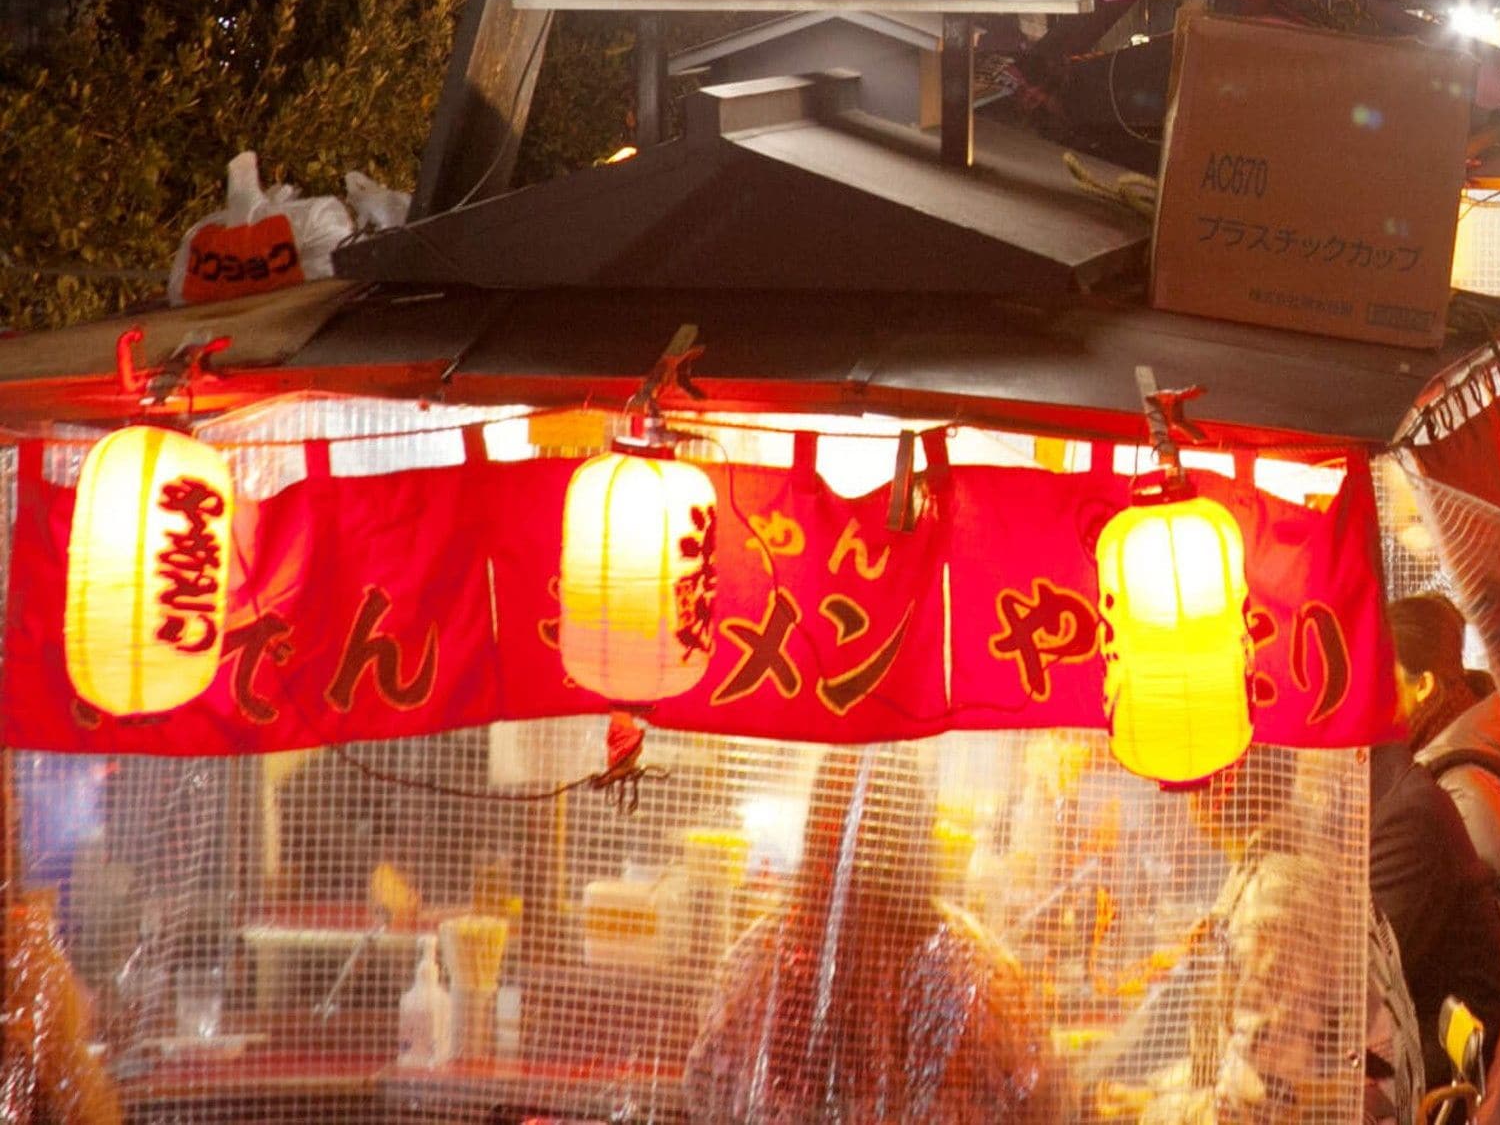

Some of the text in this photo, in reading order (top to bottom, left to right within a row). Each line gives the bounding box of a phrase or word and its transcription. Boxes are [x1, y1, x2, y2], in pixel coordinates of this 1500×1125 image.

[1195, 216, 1424, 273] プラスチックカップ
[71, 583, 441, 729] でん
